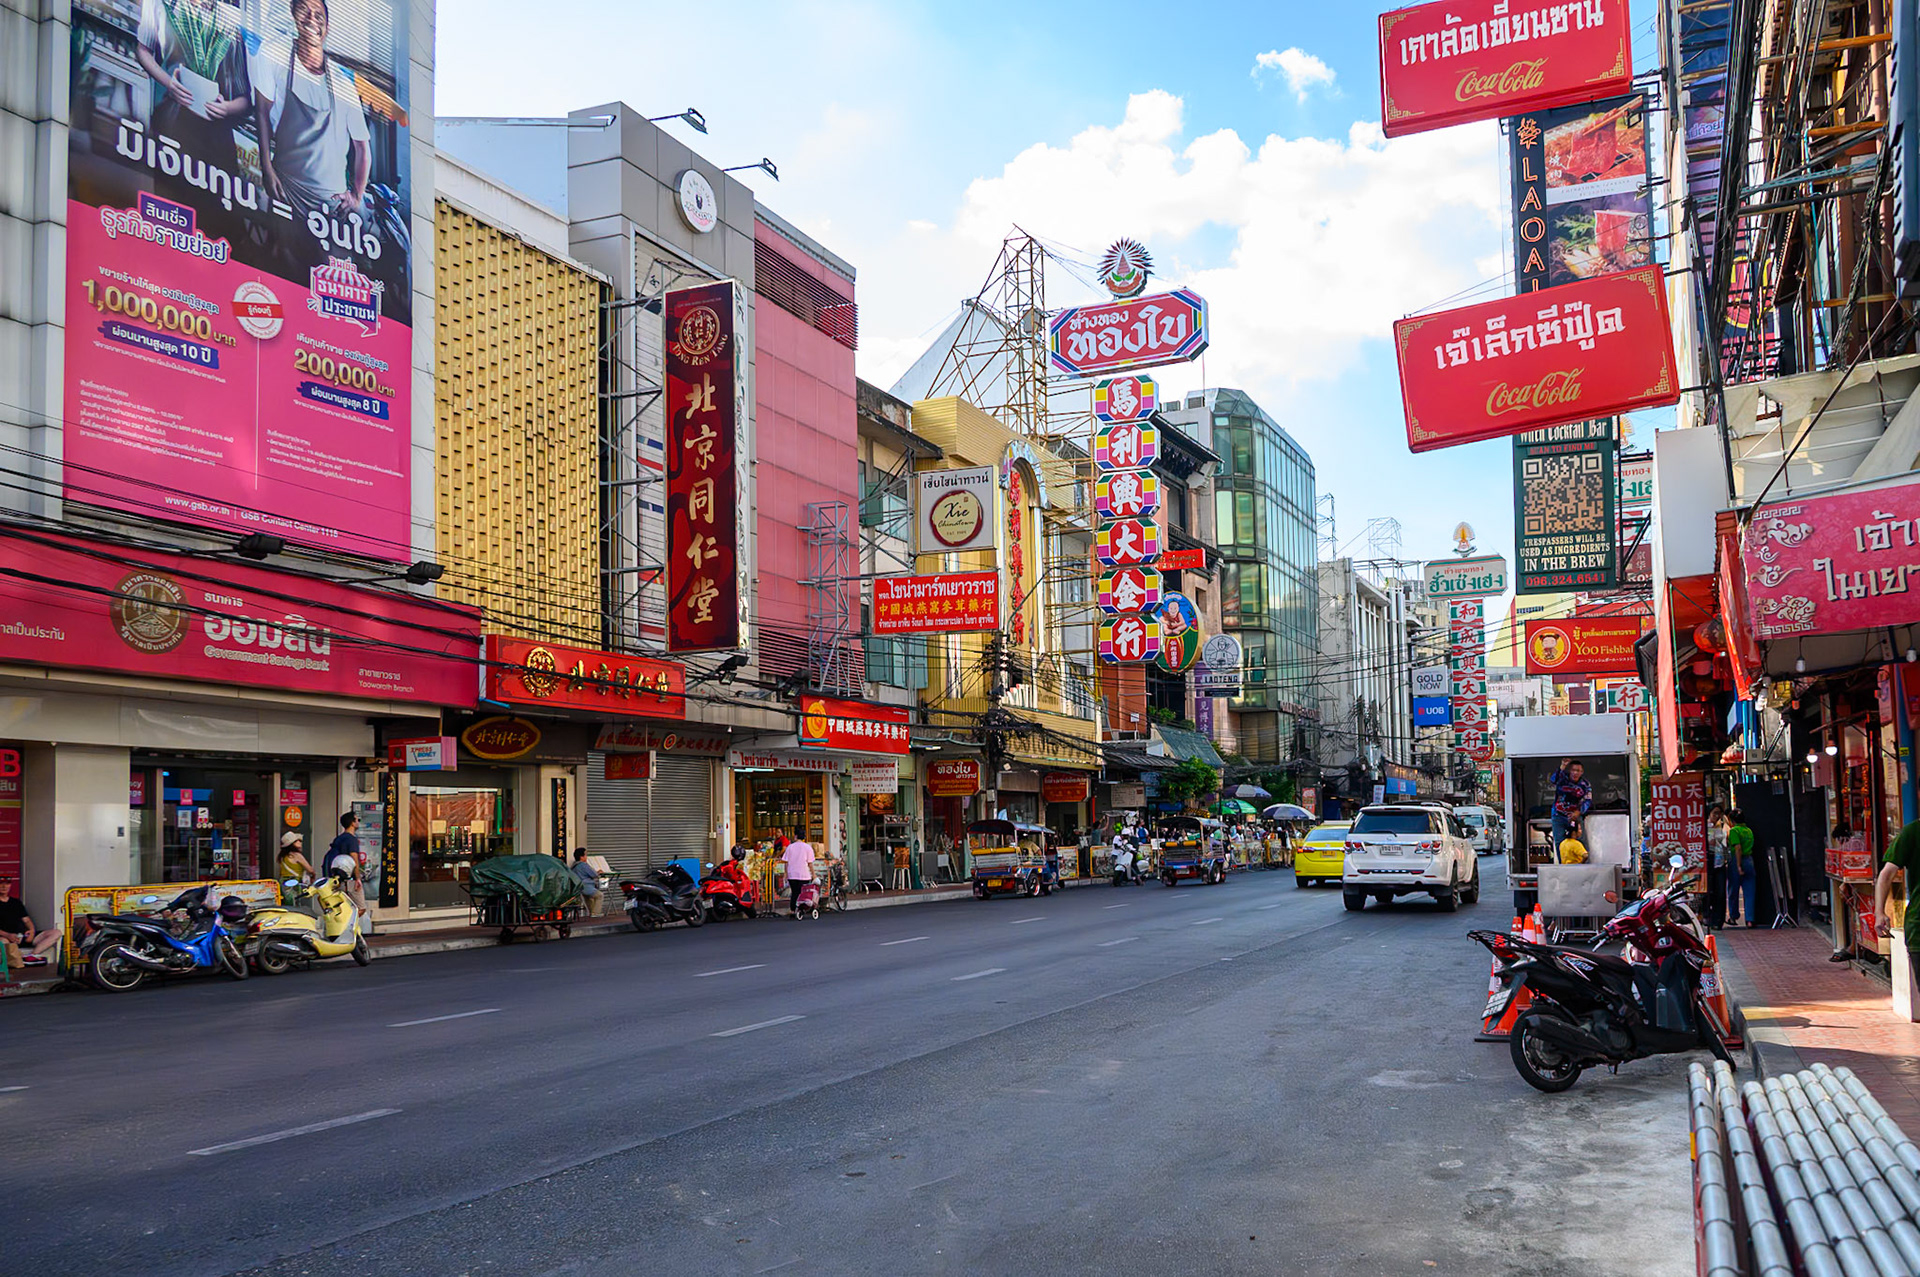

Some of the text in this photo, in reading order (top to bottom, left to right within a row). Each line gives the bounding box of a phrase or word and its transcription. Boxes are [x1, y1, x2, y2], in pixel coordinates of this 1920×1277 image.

[1400, 1, 1604, 66] เกาลัดเทียนซาน
[1455, 57, 1549, 102] Coca-Cola
[116, 118, 258, 211] มีเงินทุน
[307, 203, 381, 260] อุ่นใจ
[146, 202, 188, 227] สินเชื่อ
[101, 207, 230, 264] ธุรกิจรายย่อย
[317, 279, 369, 301] ธนาคาร
[82, 279, 236, 347] 1,000,000 บาท
[325, 299, 375, 321] ประชาชน
[1069, 310, 1130, 331] ห้างทอง
[112, 325, 212, 363] ผ่อนนานสูงสุด 10 ปี
[1066, 305, 1188, 362] ทองใบ
[671, 333, 730, 367] TONG REN TANG
[294, 348, 396, 398] 200,000 บาท
[1486, 366, 1586, 417] Coca-Cola
[362, 399, 370, 411] 8
[373, 400, 381, 414] ปี
[1588, 418, 1608, 438] Bar
[1551, 444, 1562, 453] TO
[1563, 443, 1582, 452] FIND
[1584, 441, 1596, 451] ME
[165, 496, 230, 516] www.gsb.or.th
[241, 510, 260, 522] GSB
[684, 372, 720, 625] 北京同仁堂
[944, 502, 971, 519] Xie
[938, 519, 975, 529] Chinatown
[1519, 542, 1611, 557] USED AS INGREDIENTS
[1524, 533, 1606, 547] TRESPASSERS WILL BE
[1524, 553, 1606, 572] IN THE BREW
[887, 576, 995, 600] ไชน่ามาร์ทเยาวราช
[1429, 569, 1504, 594] ฮั่วเซ่งเฮง
[1526, 573, 1606, 588] 096.324.6541
[204, 592, 243, 607] ธนาคาร
[203, 611, 331, 656] ออมสิน
[204, 645, 330, 672] Government Savings Bank
[1573, 641, 1599, 655] Yoo
[1416, 673, 1444, 684] GOLD
[1458, 602, 1481, 749] 和成興大金行
[1420, 682, 1441, 691] NOW
[1616, 685, 1641, 708] 行
[1425, 706, 1445, 716] UOB
[937, 761, 971, 775] ทองใบ
[1652, 785, 1683, 799] เกา
[286, 810, 302, 819] ria
[1653, 800, 1682, 819] ลัด
[1653, 820, 1681, 831] เทียน
[1656, 832, 1679, 841] ซาน
[214, 851, 232, 862] OPEN
